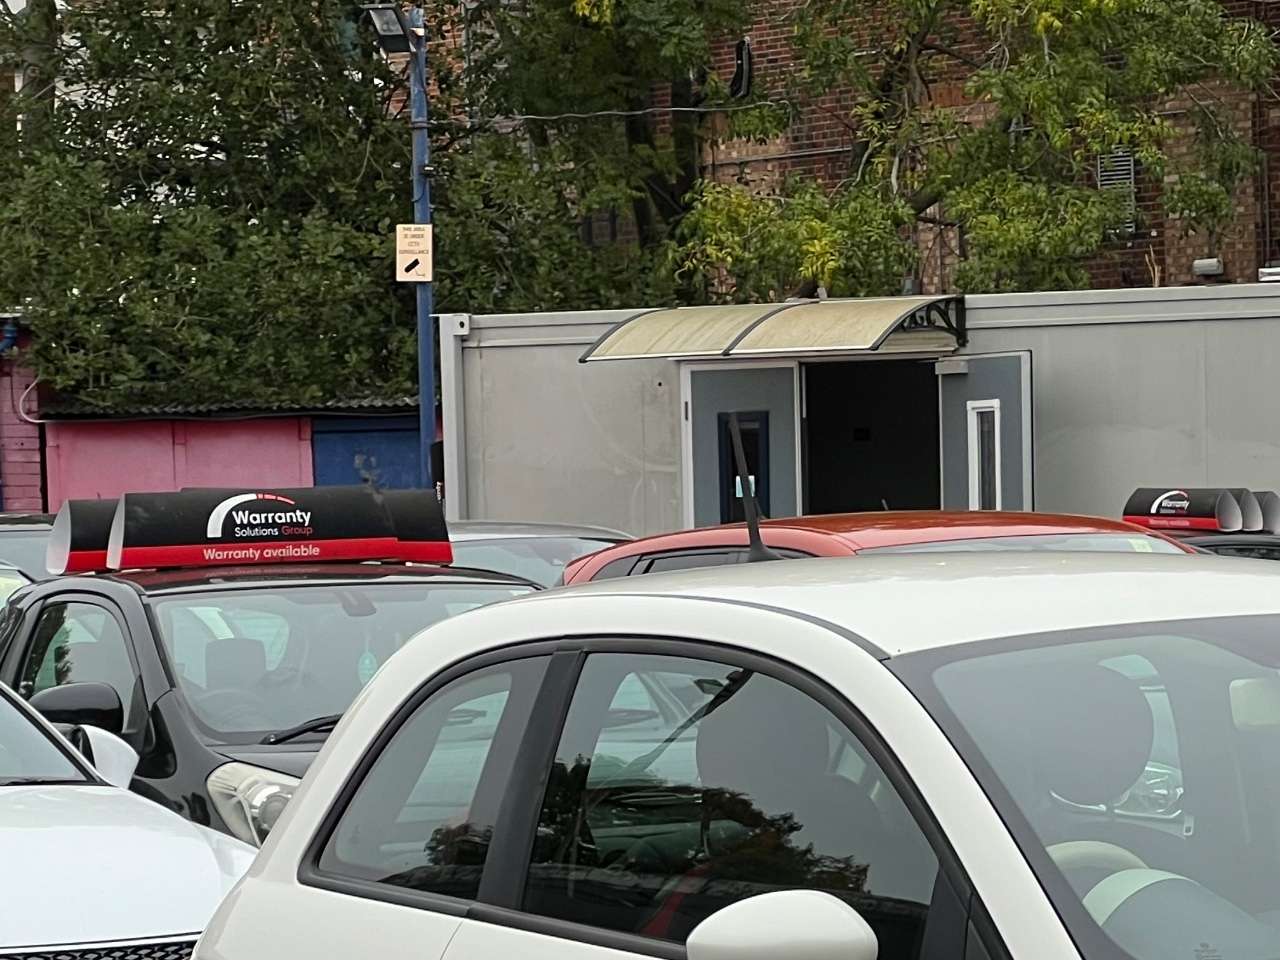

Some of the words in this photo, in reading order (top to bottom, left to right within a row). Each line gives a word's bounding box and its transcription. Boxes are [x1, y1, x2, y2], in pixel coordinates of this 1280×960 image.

[231, 509, 311, 527] Warranty
[234, 526, 279, 537] Solutions
[281, 525, 313, 537] Group
[203, 548, 260, 561] Warranty
[262, 544, 320, 558] available
